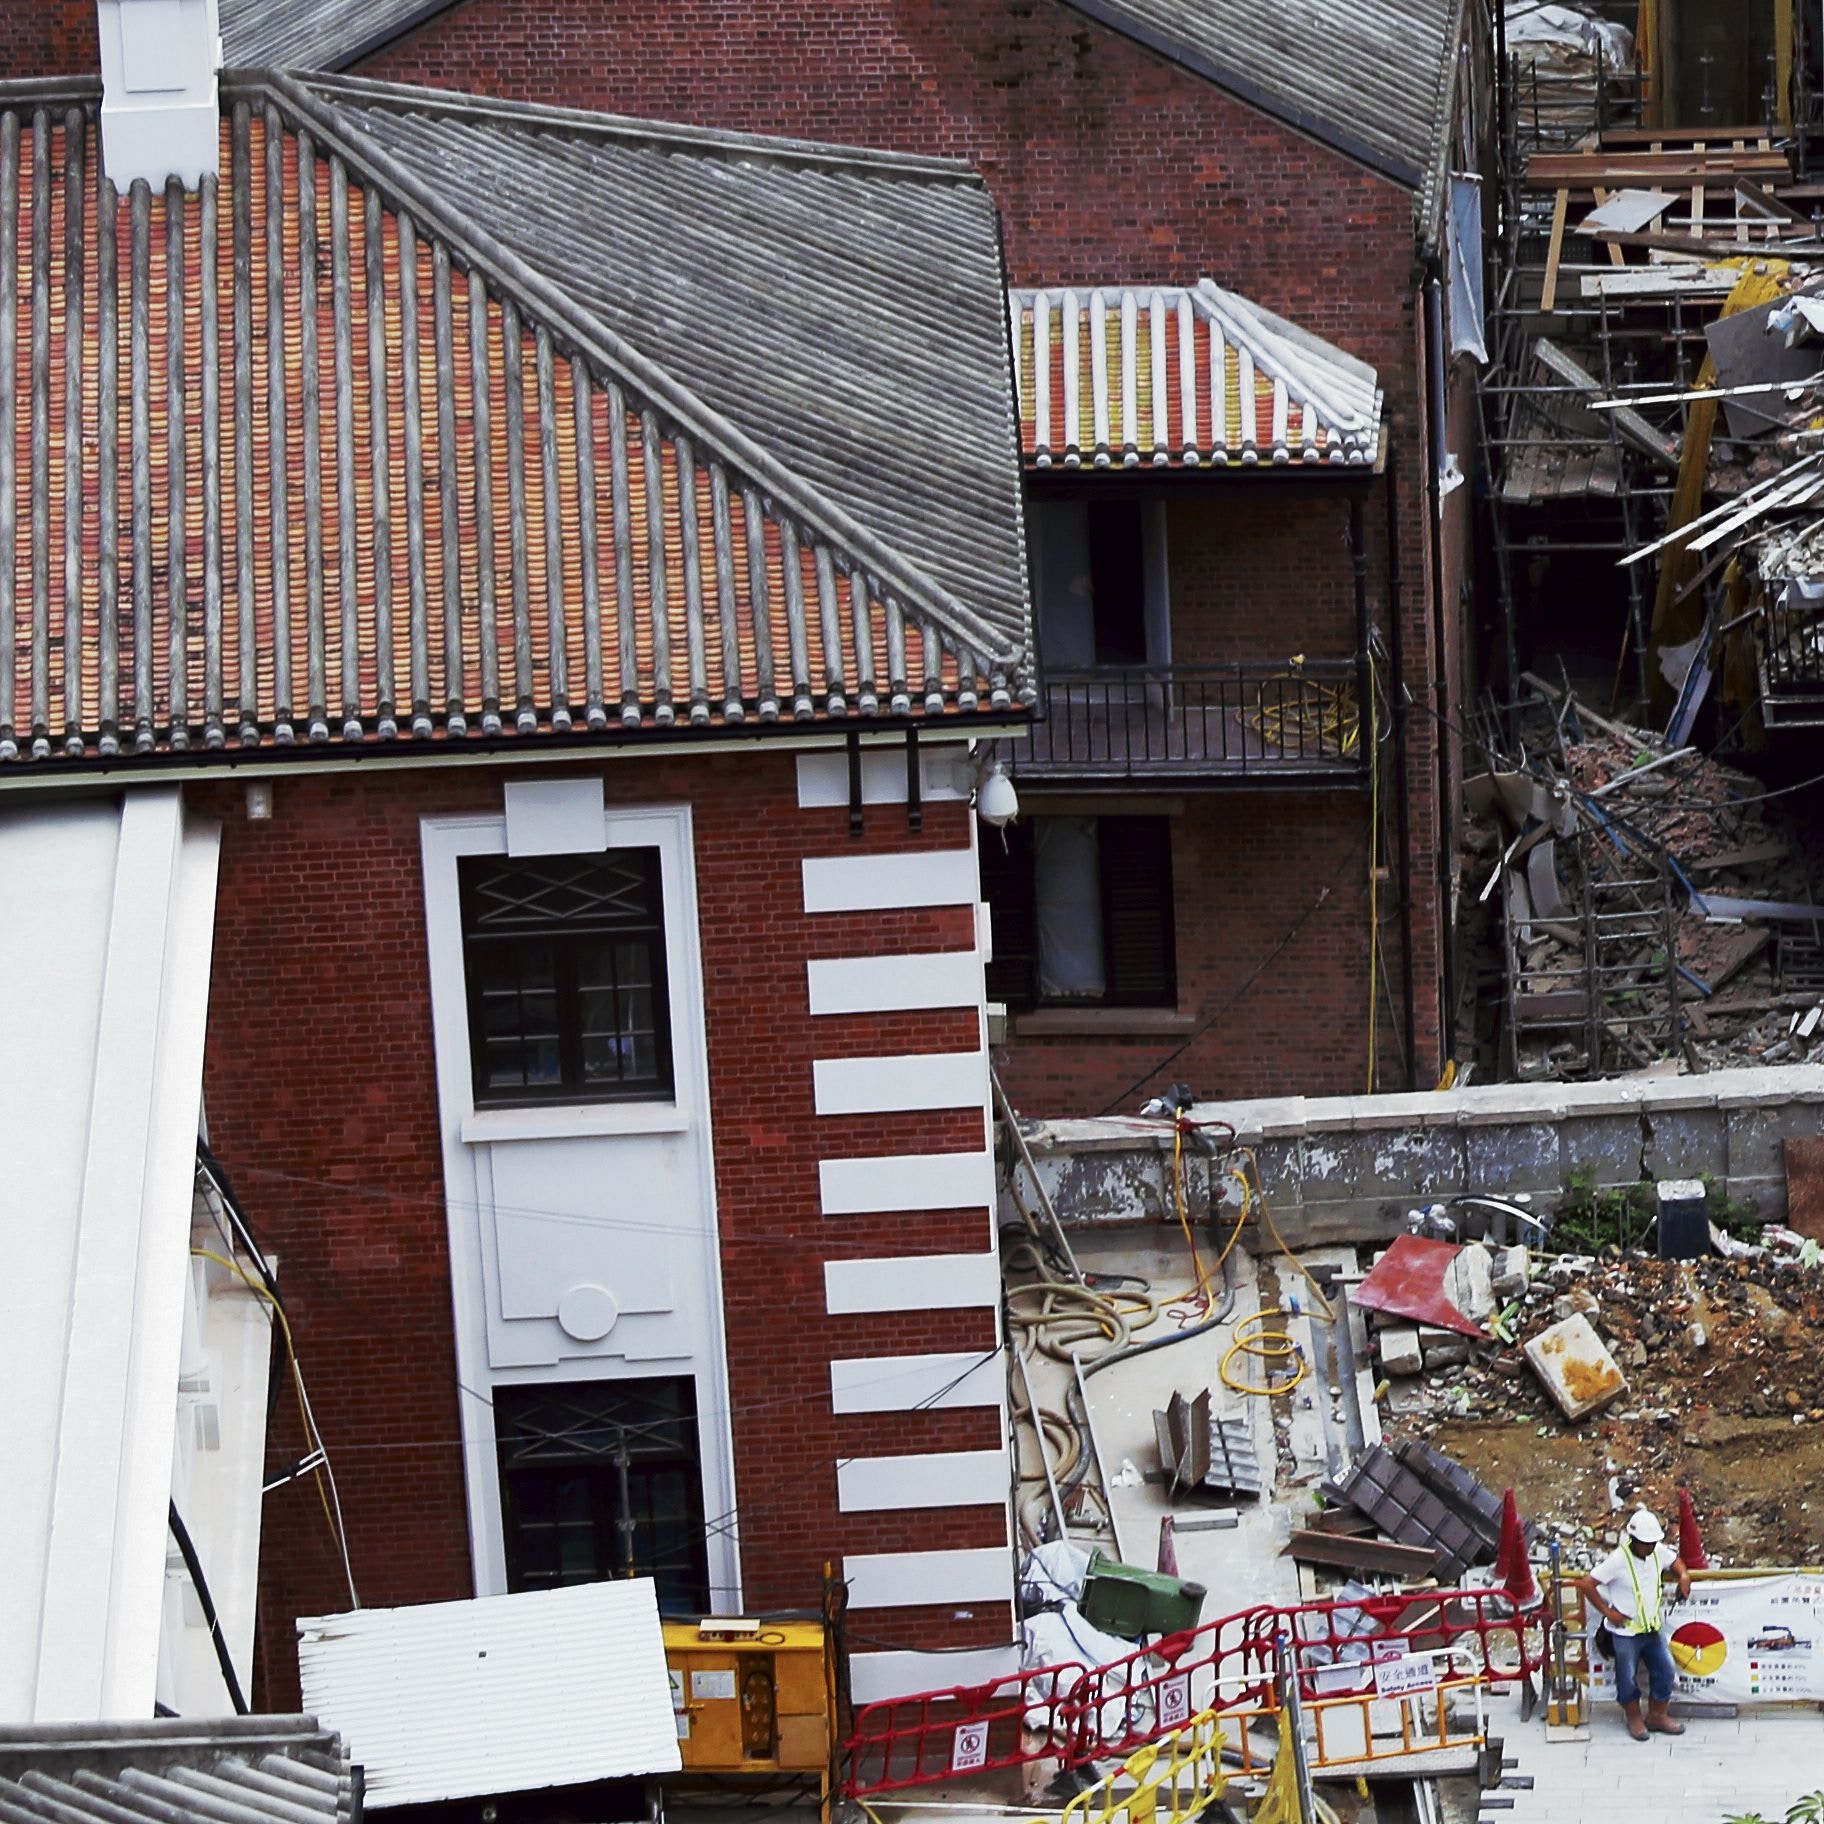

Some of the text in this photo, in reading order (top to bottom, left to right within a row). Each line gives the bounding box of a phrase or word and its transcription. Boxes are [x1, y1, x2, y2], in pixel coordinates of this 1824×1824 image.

[1380, 1663, 1429, 1683] 安全通道
[1381, 1679, 1433, 1693] Safety Access
